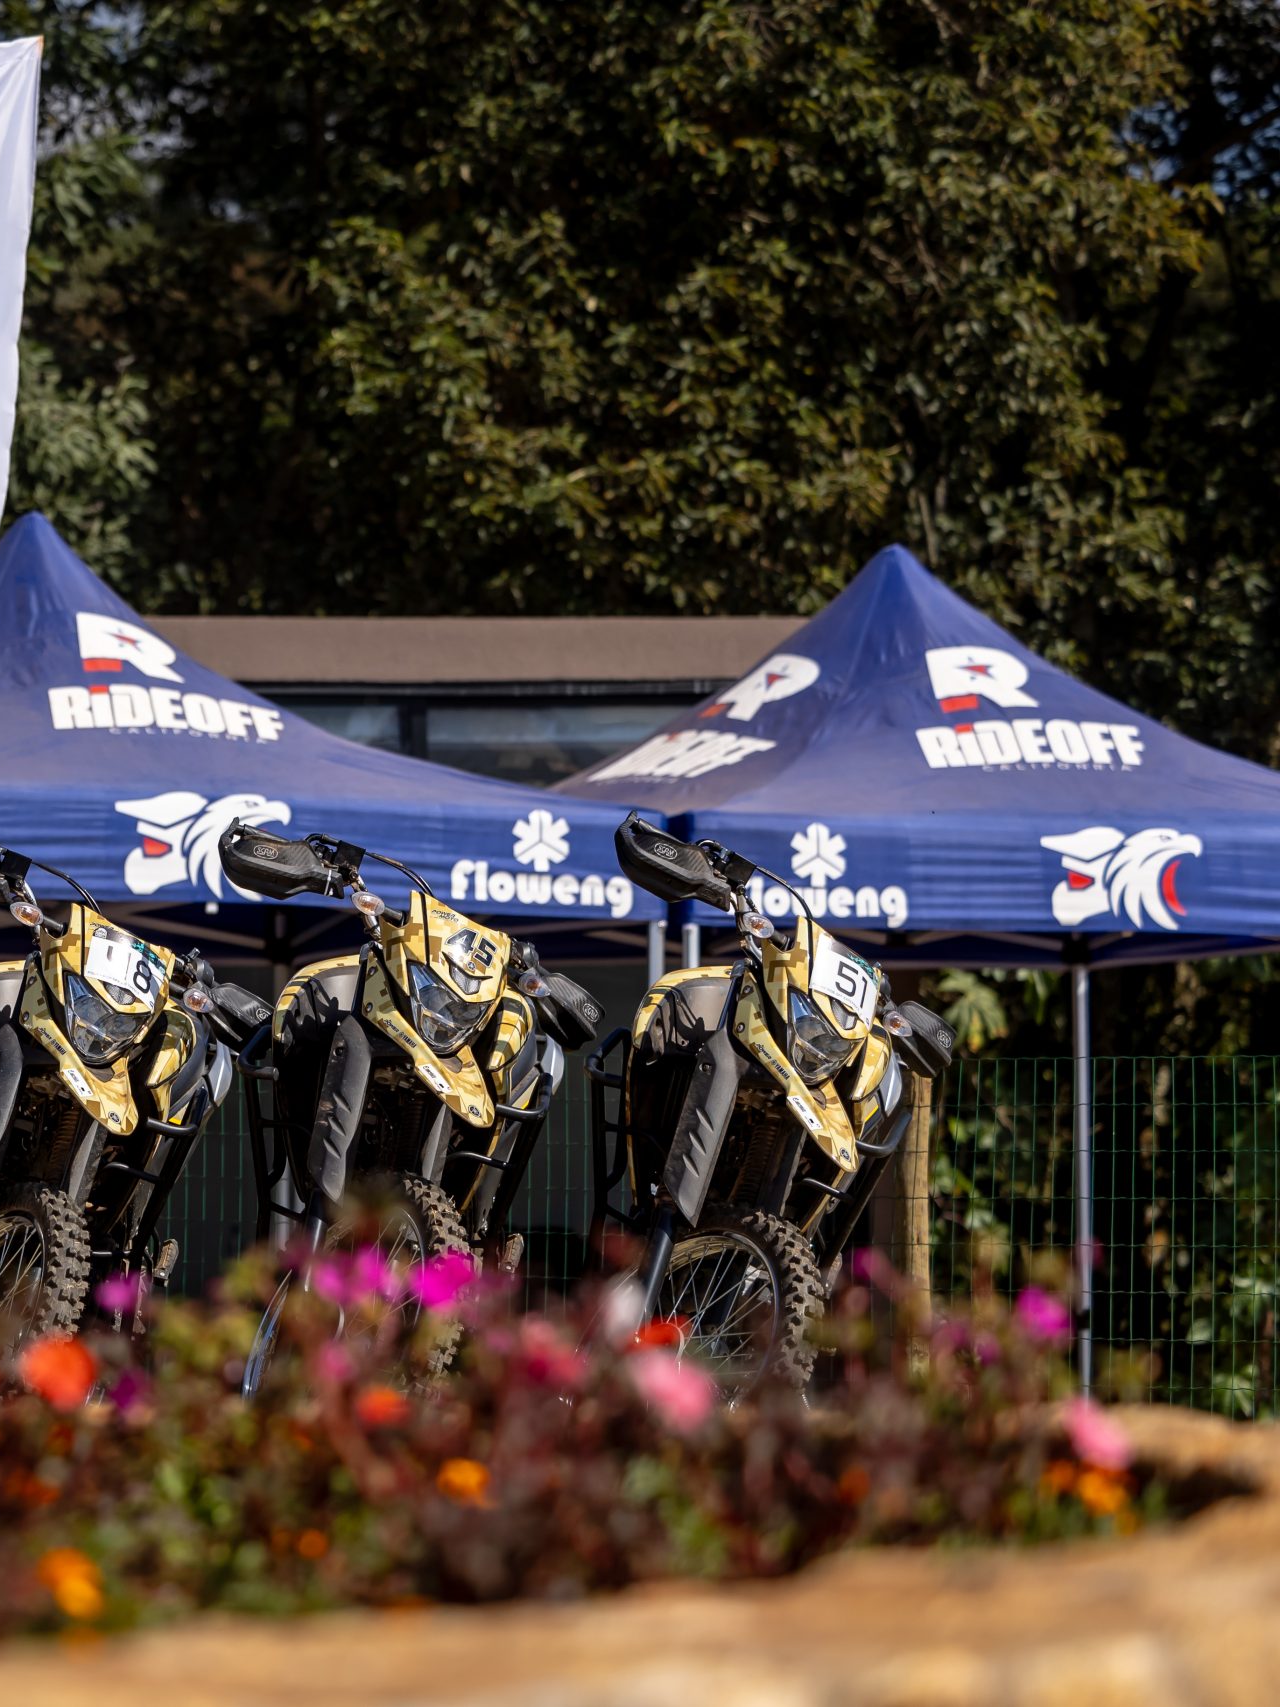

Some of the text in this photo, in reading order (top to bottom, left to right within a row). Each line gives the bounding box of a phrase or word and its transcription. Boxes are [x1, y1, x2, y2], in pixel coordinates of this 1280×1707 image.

[450, 859, 634, 919] floweng
[728, 875, 908, 929] loweng
[445, 927, 499, 968] 45
[835, 960, 868, 1009] 51
